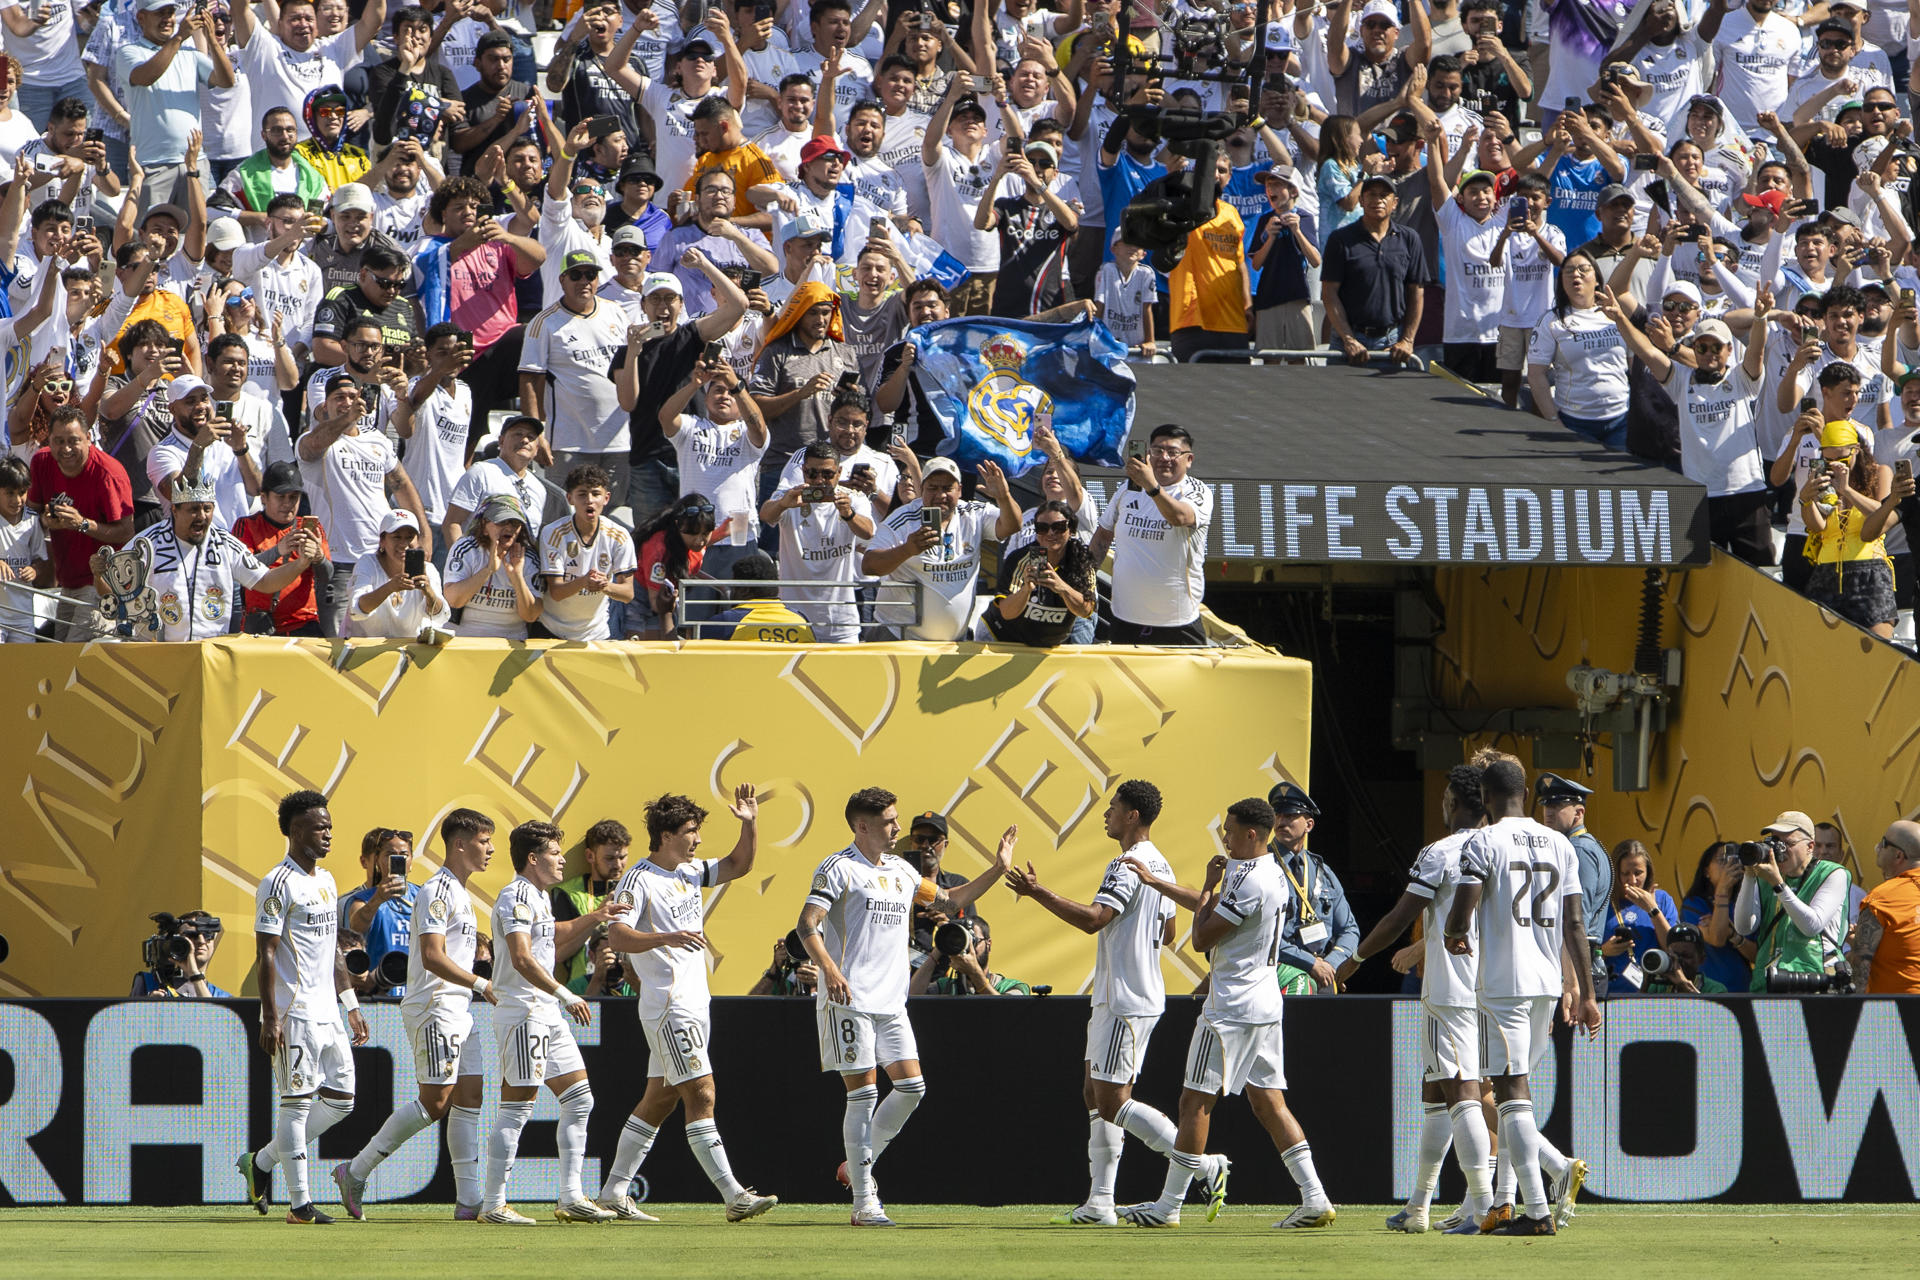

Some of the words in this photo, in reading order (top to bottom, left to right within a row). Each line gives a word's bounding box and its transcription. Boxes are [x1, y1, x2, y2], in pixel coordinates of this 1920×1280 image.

[1554, 187, 1600, 201] Emirate
[386, 226, 420, 242] bwi
[328, 266, 361, 281] Emirate
[1486, 276, 1505, 288] BETT
[1572, 328, 1619, 342] Emirate
[573, 344, 620, 362] Emirate
[1688, 398, 1736, 413] Emirates
[692, 441, 741, 457] Emirates
[709, 455, 733, 467] BETTER
[1124, 512, 1173, 530] Emirates
[1206, 483, 1363, 558] LIFE
[1385, 485, 1673, 563] STADIUM
[1128, 527, 1140, 537] FLY
[1141, 529, 1165, 541] BETTER
[820, 537, 835, 549] Fly
[802, 544, 852, 561] Emirates
[922, 560, 973, 573] Emirates
[932, 572, 945, 583] FLY
[946, 571, 968, 581] BETTER
[487, 597, 515, 609] BETTER
[1023, 600, 1068, 623] Teka
[758, 628, 799, 643] CSC
[1509, 860, 1560, 928] 22
[866, 897, 907, 914] Emirates
[870, 913, 882, 925] FLY
[883, 913, 902, 926] BETTER
[840, 1018, 856, 1044] 8
[438, 1033, 460, 1059] 15
[529, 1034, 550, 1060] 20
[673, 1025, 703, 1054] 30
[289, 1044, 303, 1072] 7
